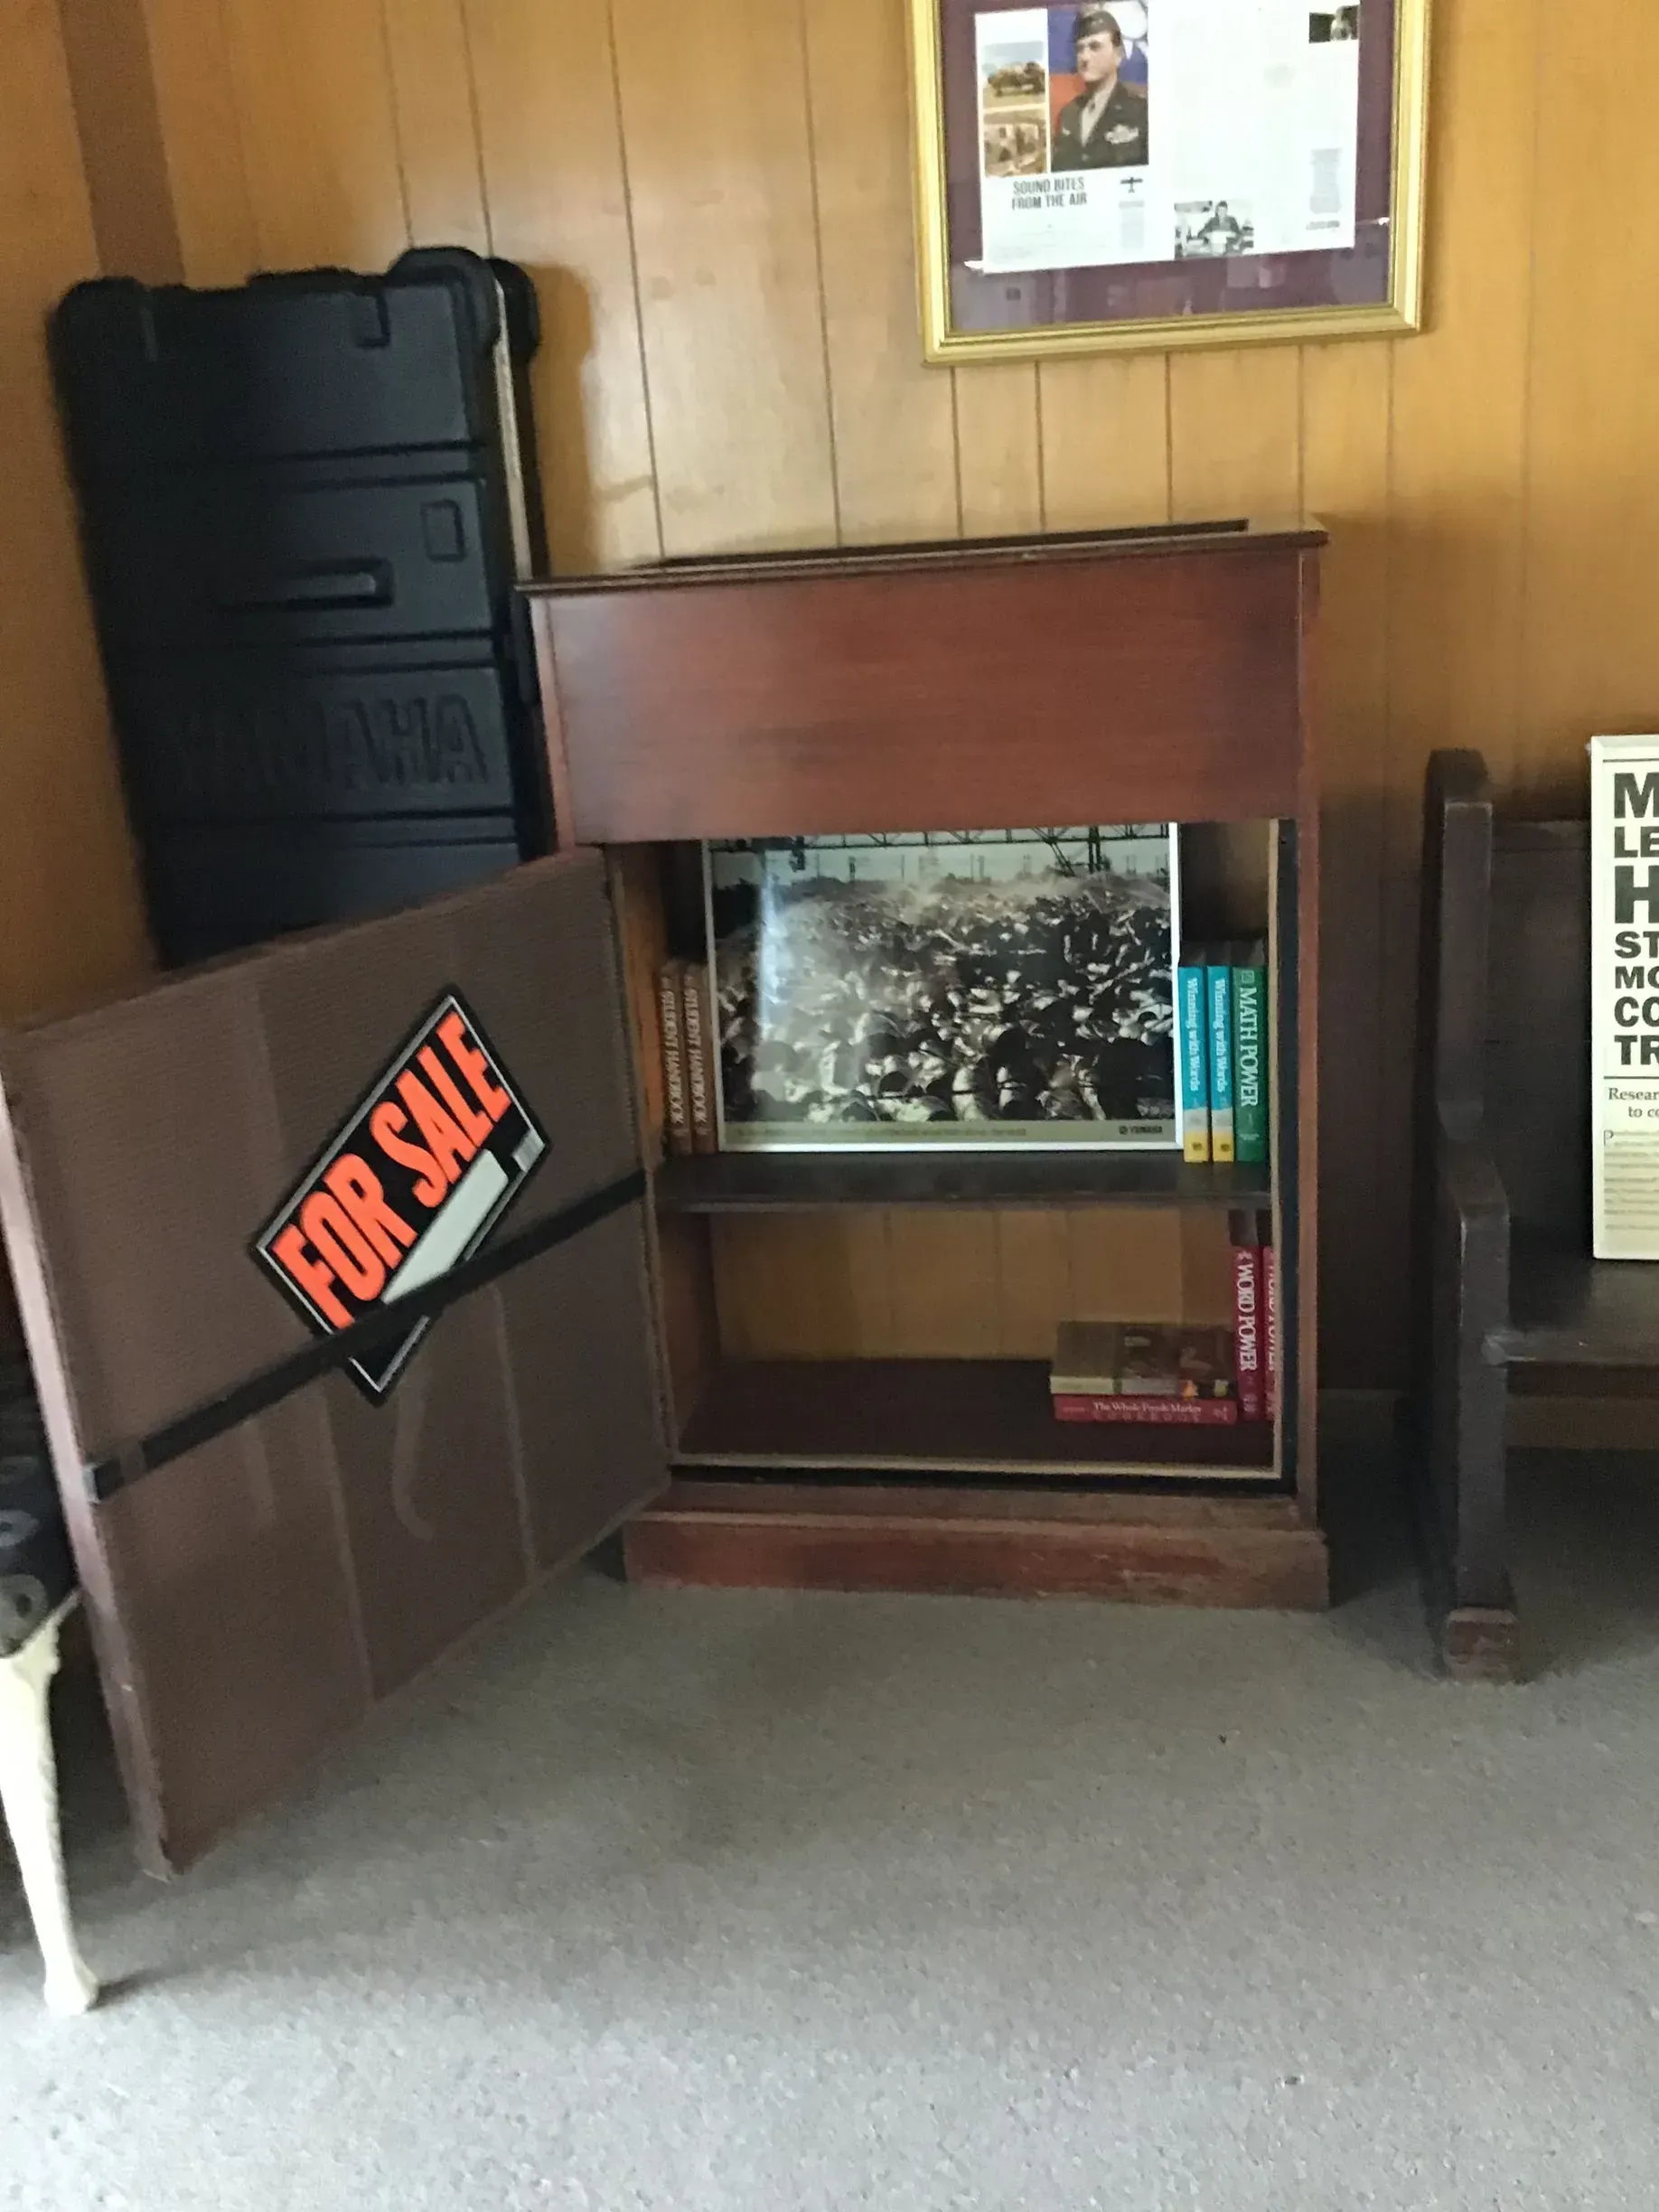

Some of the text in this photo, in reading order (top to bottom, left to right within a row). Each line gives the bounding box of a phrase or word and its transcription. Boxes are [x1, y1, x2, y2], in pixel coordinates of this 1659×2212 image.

[1011, 192, 1088, 211] FROM THE AIR
[1013, 179, 1051, 195] SOUND
[1186, 977, 1201, 1092] Winning with Words
[1213, 978, 1229, 1092] Winning with Words
[1239, 987, 1258, 1042] MATH
[1239, 1044, 1260, 1108] POWER
[1628, 1106, 1643, 1118] to
[271, 1010, 511, 1329] FOR SALE
[1236, 1263, 1256, 1313] WORD
[1238, 1315, 1258, 1372] POWER
